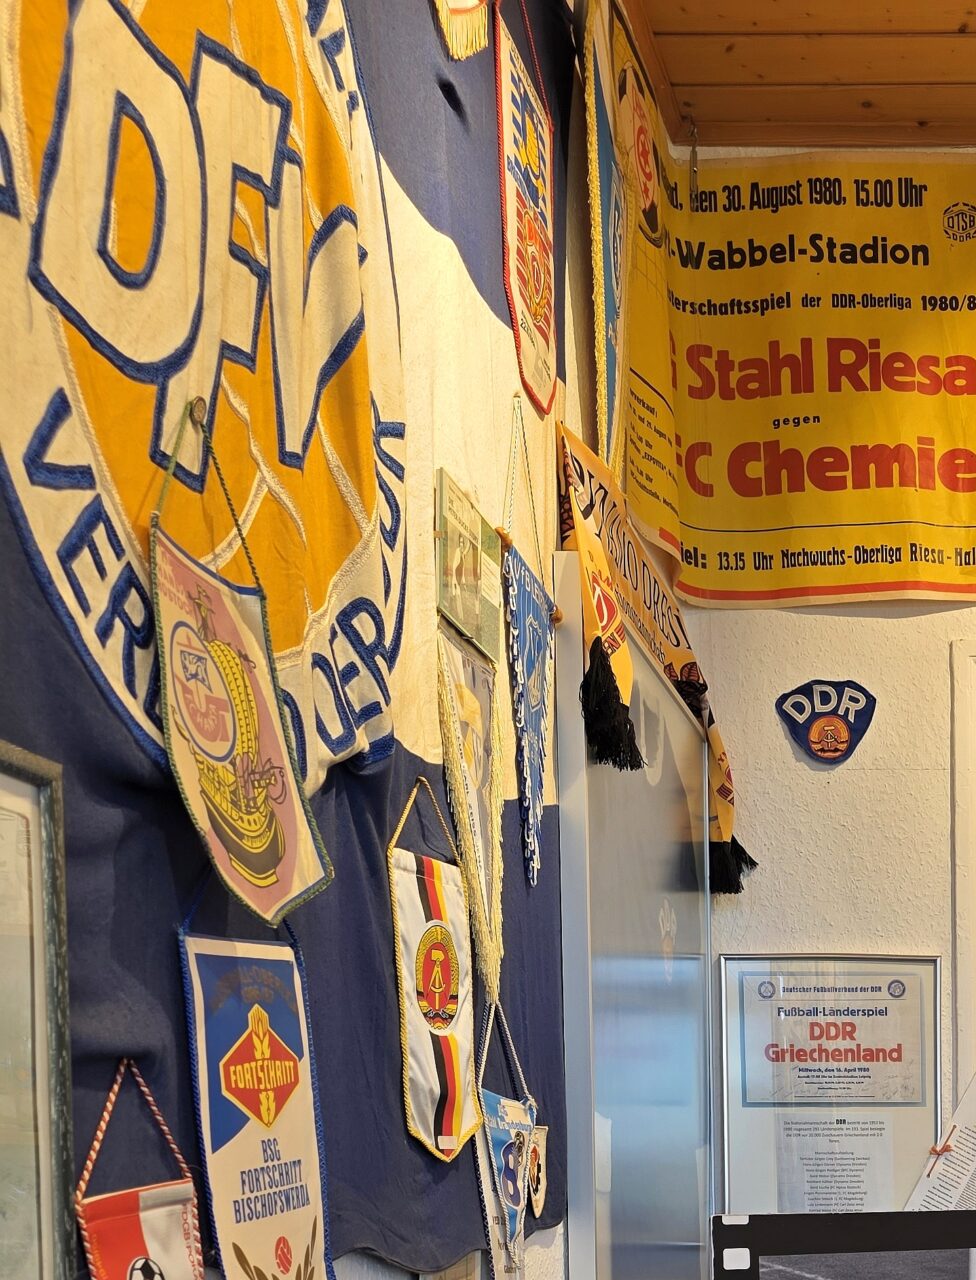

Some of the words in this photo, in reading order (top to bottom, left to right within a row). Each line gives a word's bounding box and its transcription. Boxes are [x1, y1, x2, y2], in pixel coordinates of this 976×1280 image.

[721, 185, 746, 213] 30.
[750, 180, 803, 214] August
[807, 177, 847, 206] 1980,
[853, 178, 893, 208] 15.00
[897, 177, 928, 208] Uhr
[946, 211, 976, 235] DTSB
[28, 0, 367, 495] DFV
[801, 293, 822, 308] der
[831, 293, 912, 311] DDR-Oberliga
[686, 337, 814, 400] Stahl
[772, 412, 821, 430] gegen
[717, 546, 746, 571] 13.15
[753, 545, 774, 570] Uhr
[781, 541, 902, 570] Nachwuchs-Oberliga
[782, 684, 870, 725] DDR
[777, 1007, 888, 1018] Fußball-Länderspiel
[809, 1021, 857, 1041] DDR
[764, 1043, 903, 1063] Griechenland
[229, 1058, 295, 1091] FORTSCHRITT
[843, 1067, 857, 1075] April
[261, 1138, 281, 1164] BSG
[240, 1159, 303, 1196] FORTSCHRITT
[232, 1183, 311, 1224] BISCHOFSWERDA
